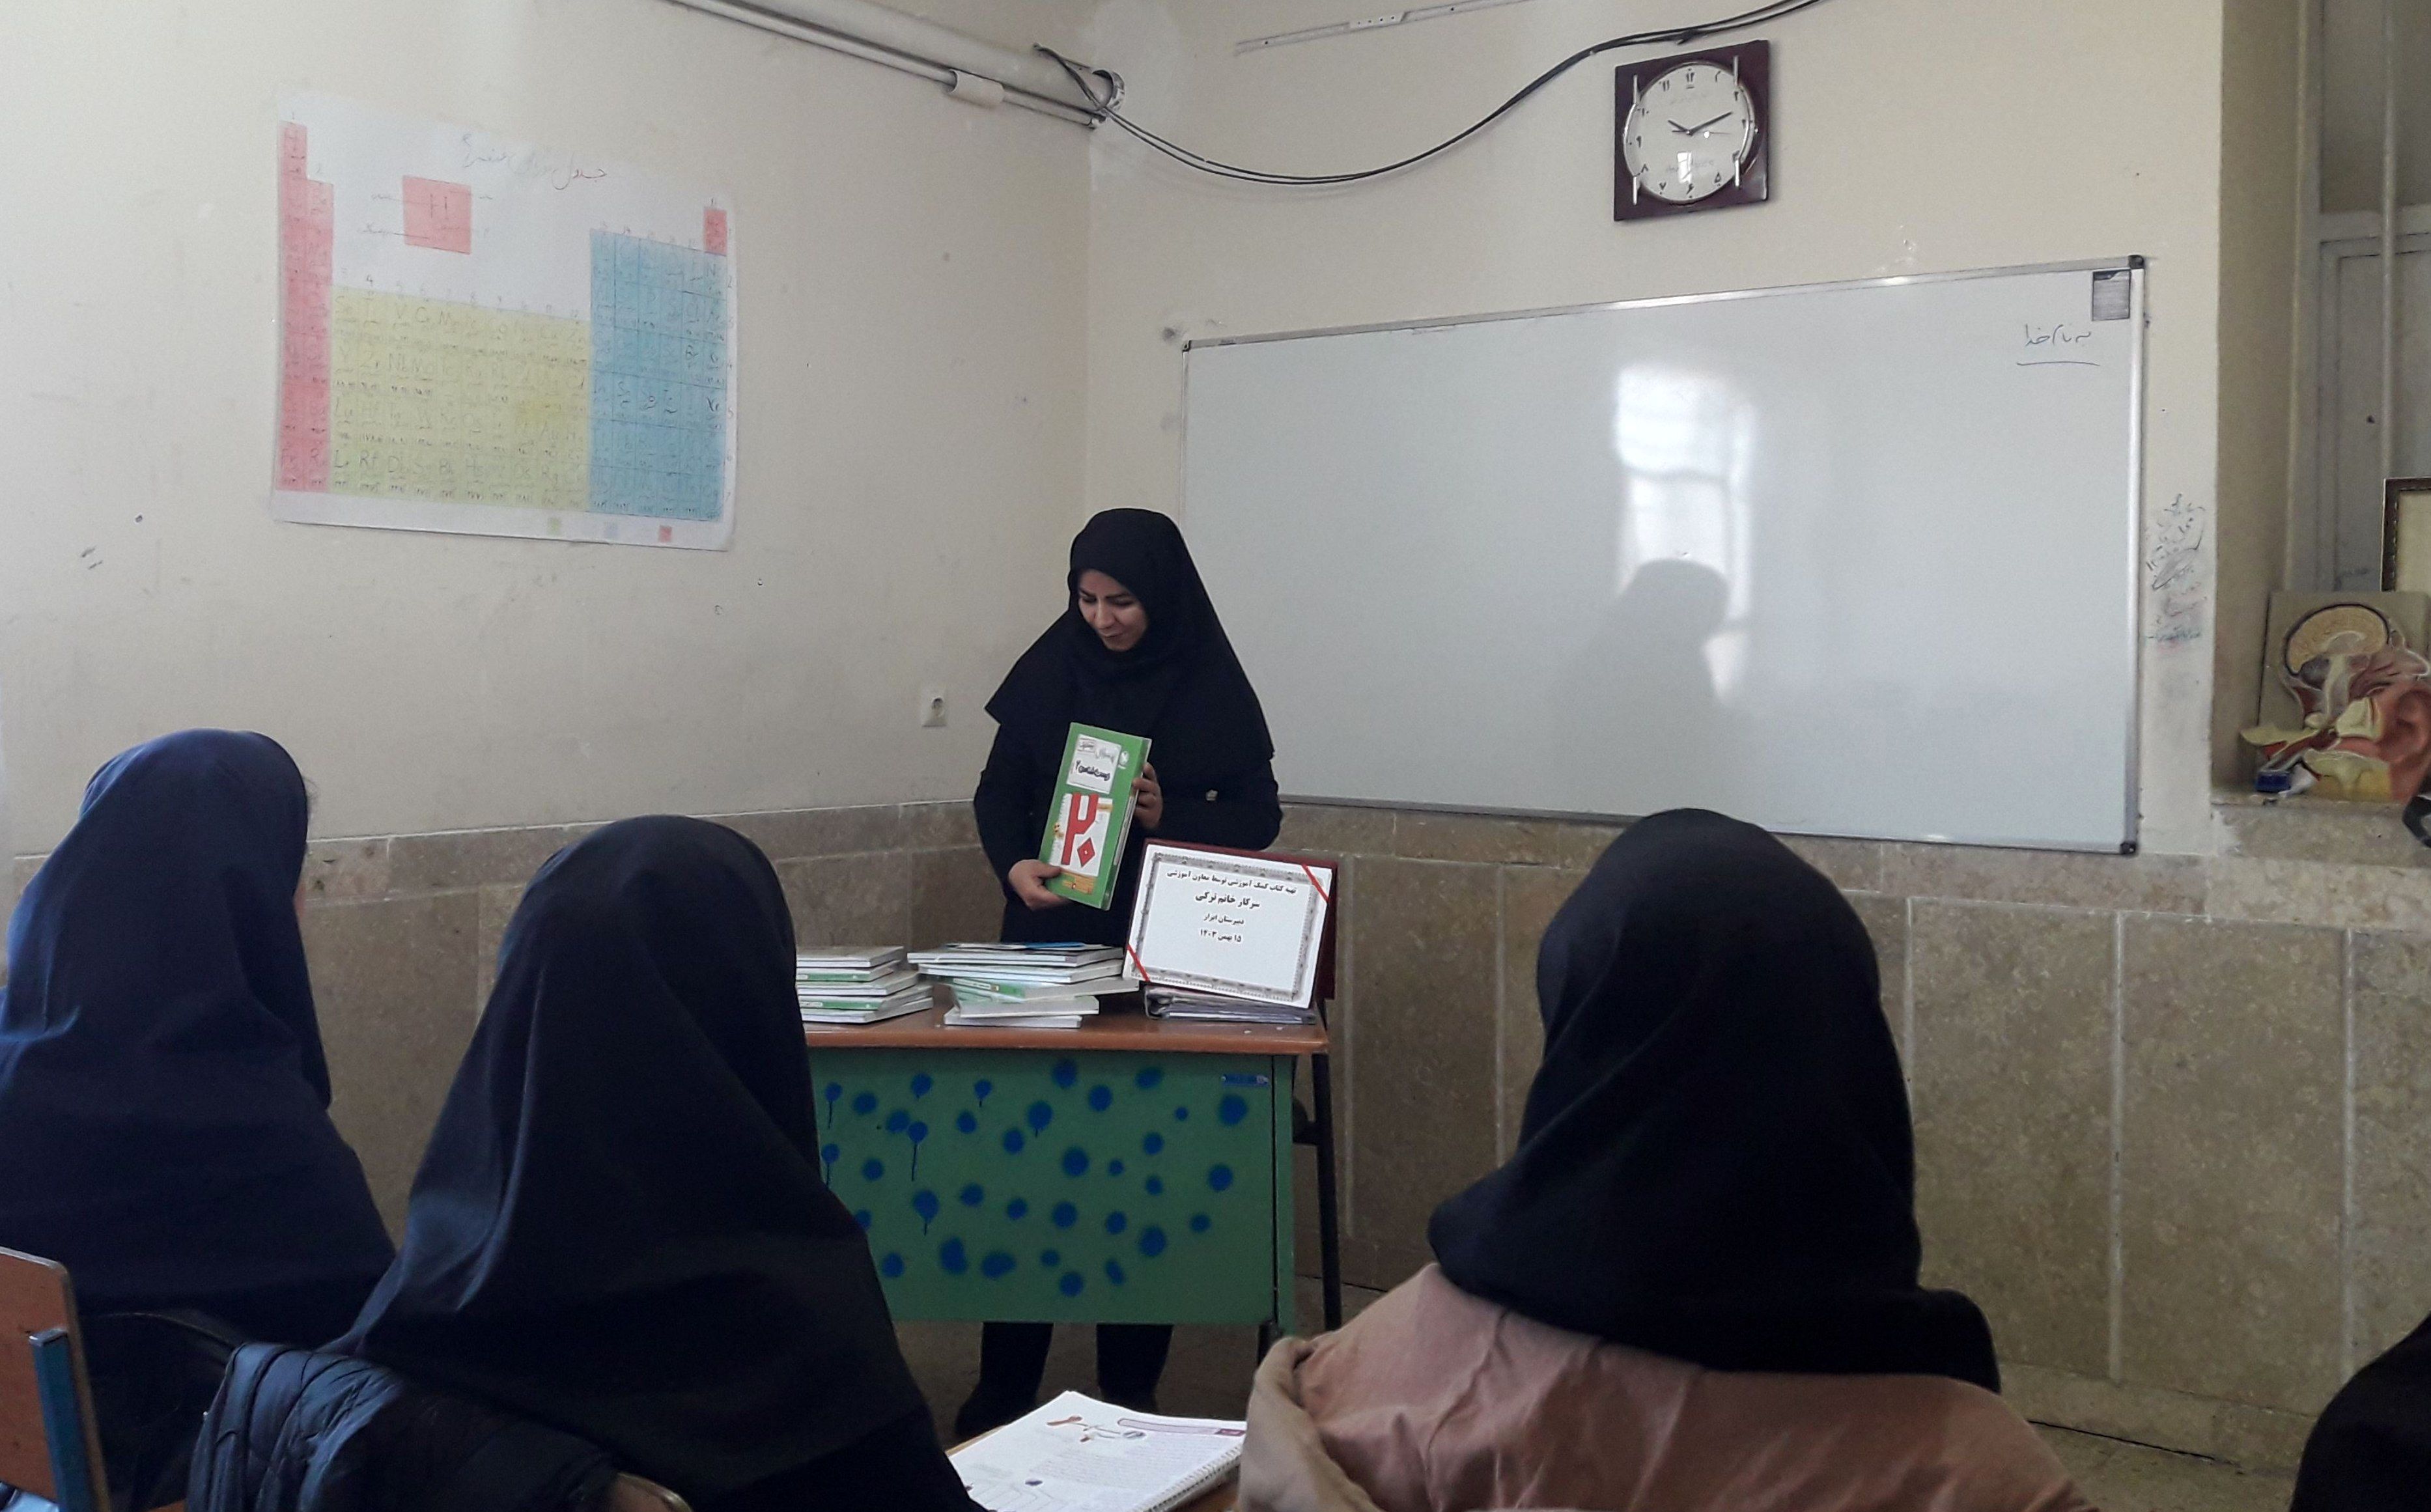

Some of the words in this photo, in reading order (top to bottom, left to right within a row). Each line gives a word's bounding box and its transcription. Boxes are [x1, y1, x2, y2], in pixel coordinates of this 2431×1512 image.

[1636, 135, 1642, 148] ۹
[1714, 172, 1722, 184] ۵
[2025, 323, 2051, 346] خدا
[1166, 869, 1192, 878] آموزشی
[1192, 873, 1210, 882] معاون
[1211, 875, 1227, 885] توسط
[1228, 879, 1252, 888] آموزشی
[1217, 894, 1236, 905] خانم
[1237, 897, 1260, 909] سرکار
[1203, 913, 1218, 922] ابرار
[1218, 915, 1244, 925] دبیرستان
[1234, 934, 1242, 943] ۱۵
